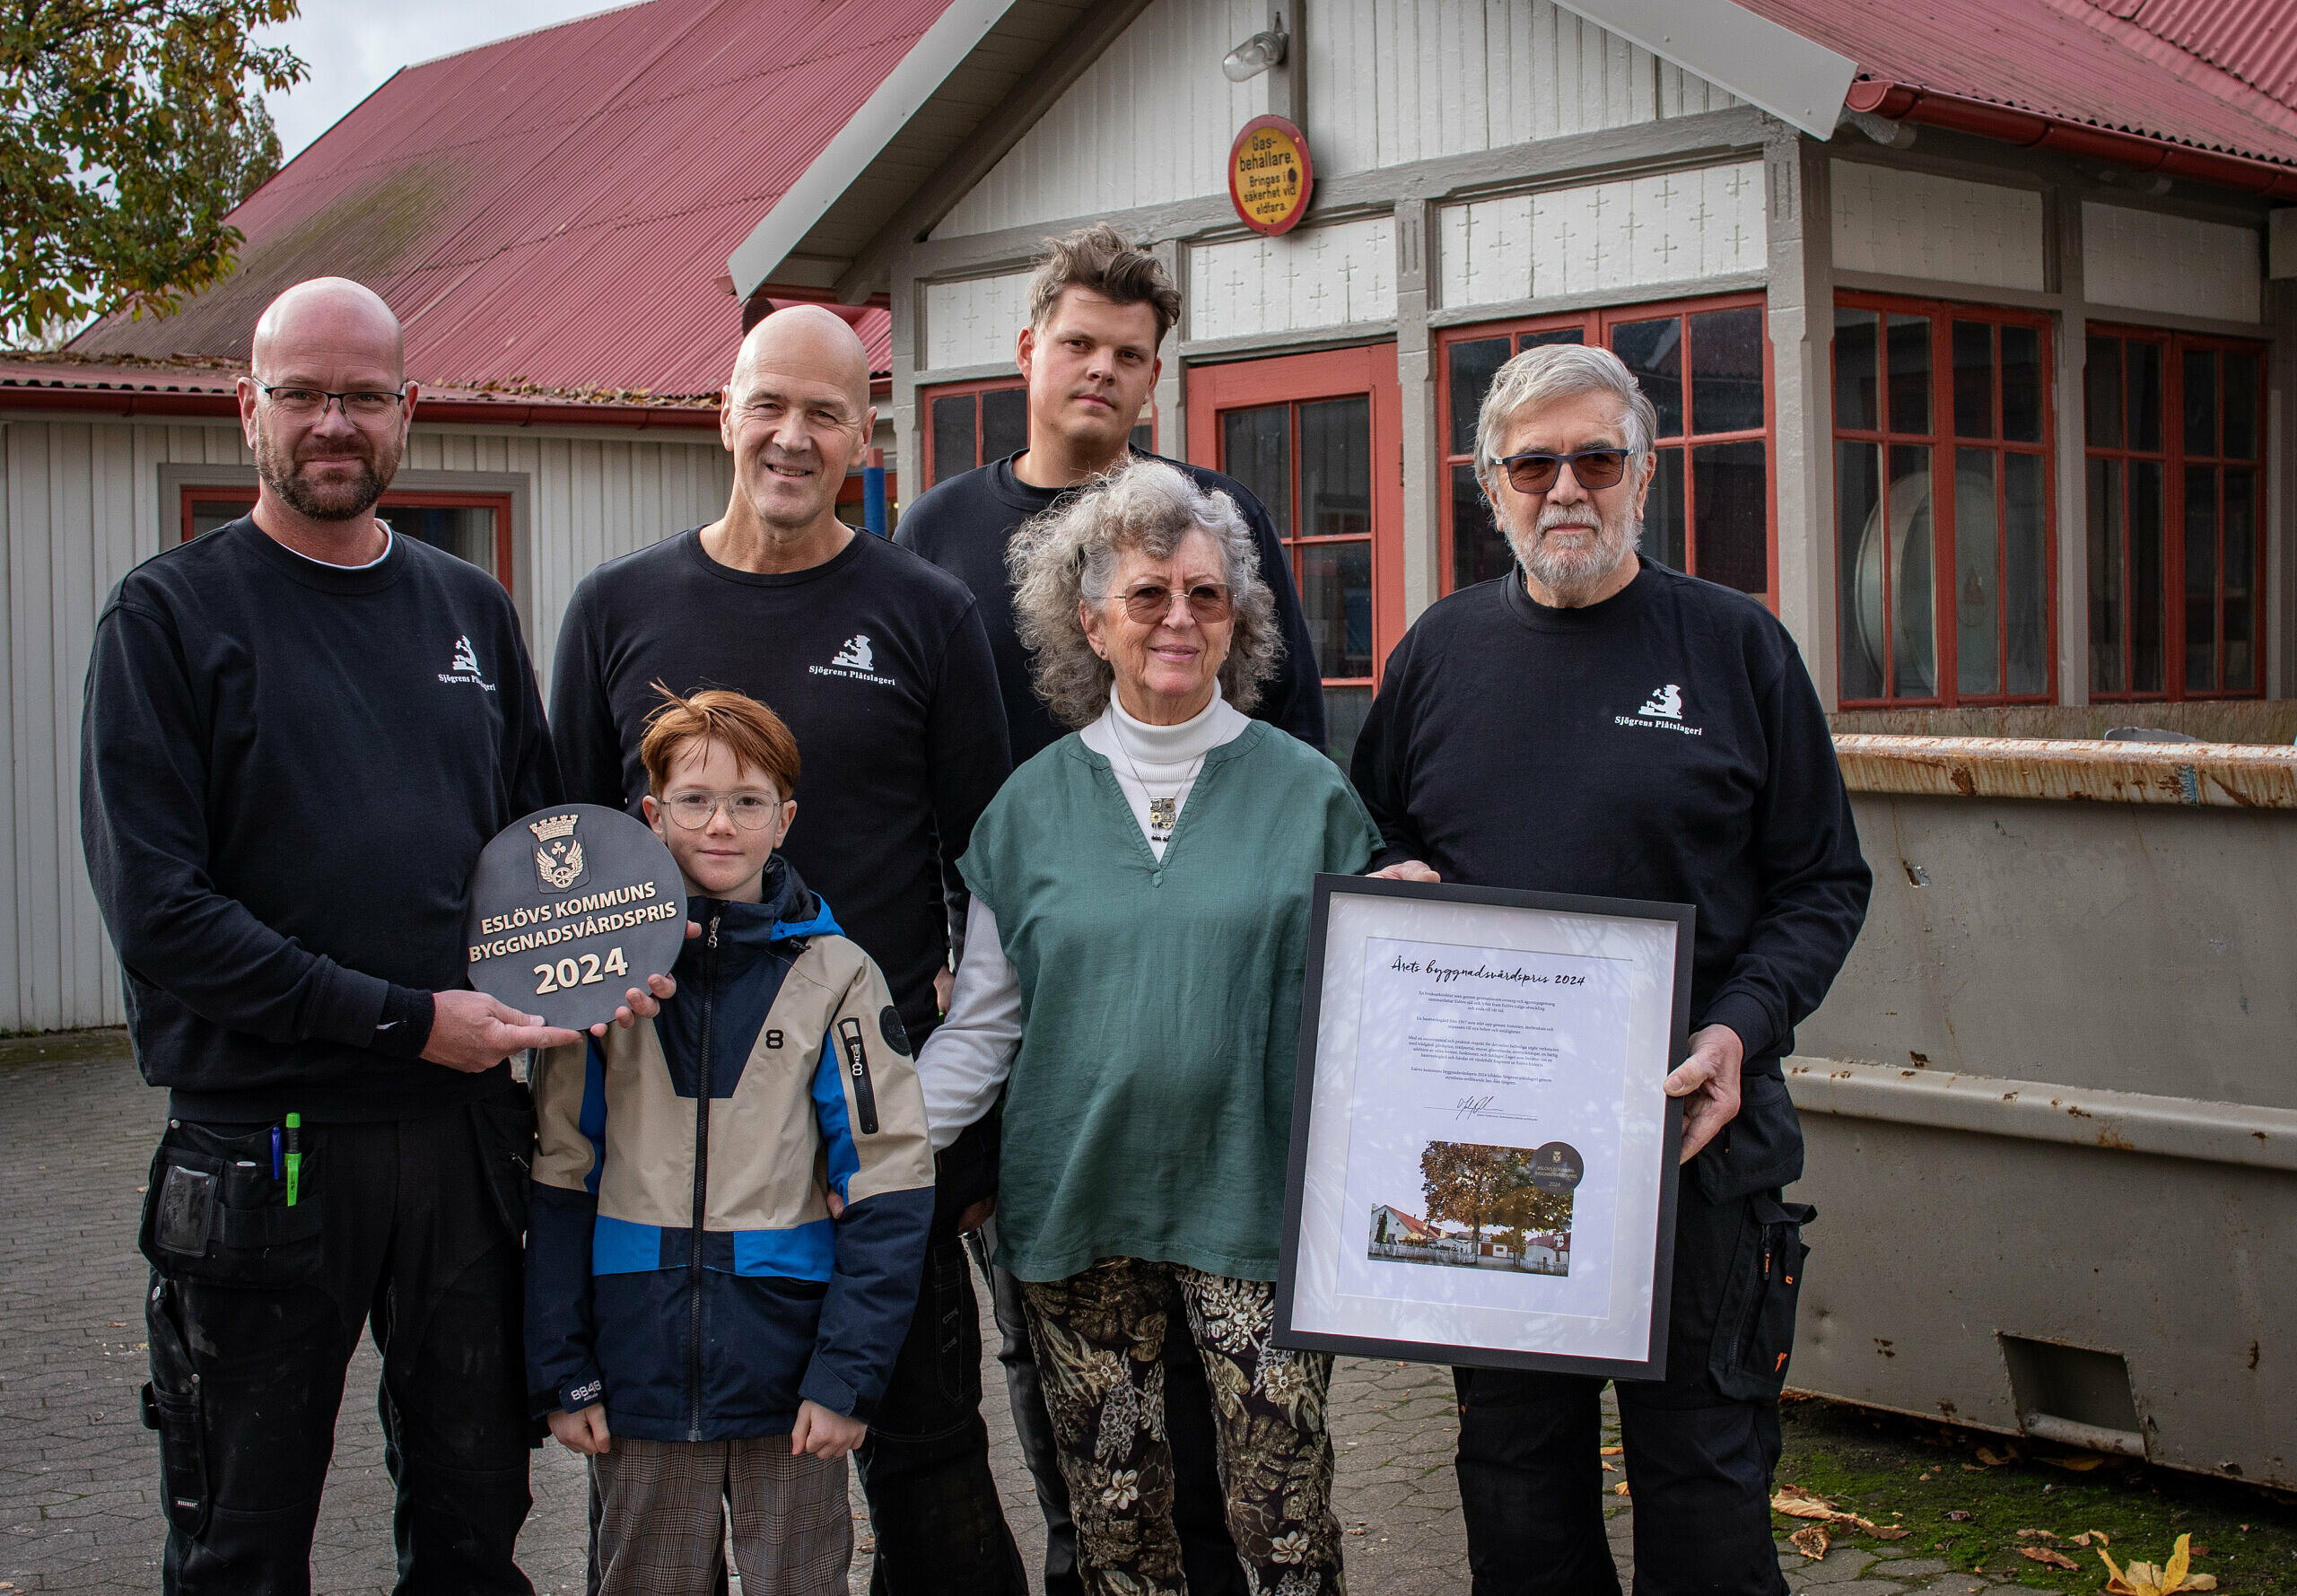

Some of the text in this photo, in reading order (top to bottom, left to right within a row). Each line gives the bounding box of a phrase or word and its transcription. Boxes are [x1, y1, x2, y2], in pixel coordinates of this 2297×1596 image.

[1253, 136, 1277, 151] Gas-
[1249, 175, 1280, 188] Bringas
[1244, 188, 1280, 202] säkerhet
[438, 674, 470, 684] Sjögrens
[808, 665, 896, 686] Sjögrens Plåtslageri
[1614, 716, 1703, 736] Sjögrens Plåtslageri
[481, 881, 657, 936] ESLÖVS KOMMUNS
[468, 901, 677, 963] BYGGNADSVÅRDSPRIS
[533, 946, 629, 995] 2024
[1391, 955, 1585, 987] Årets byggnadsvårdspris 2024
[571, 1380, 602, 1400] 8848
